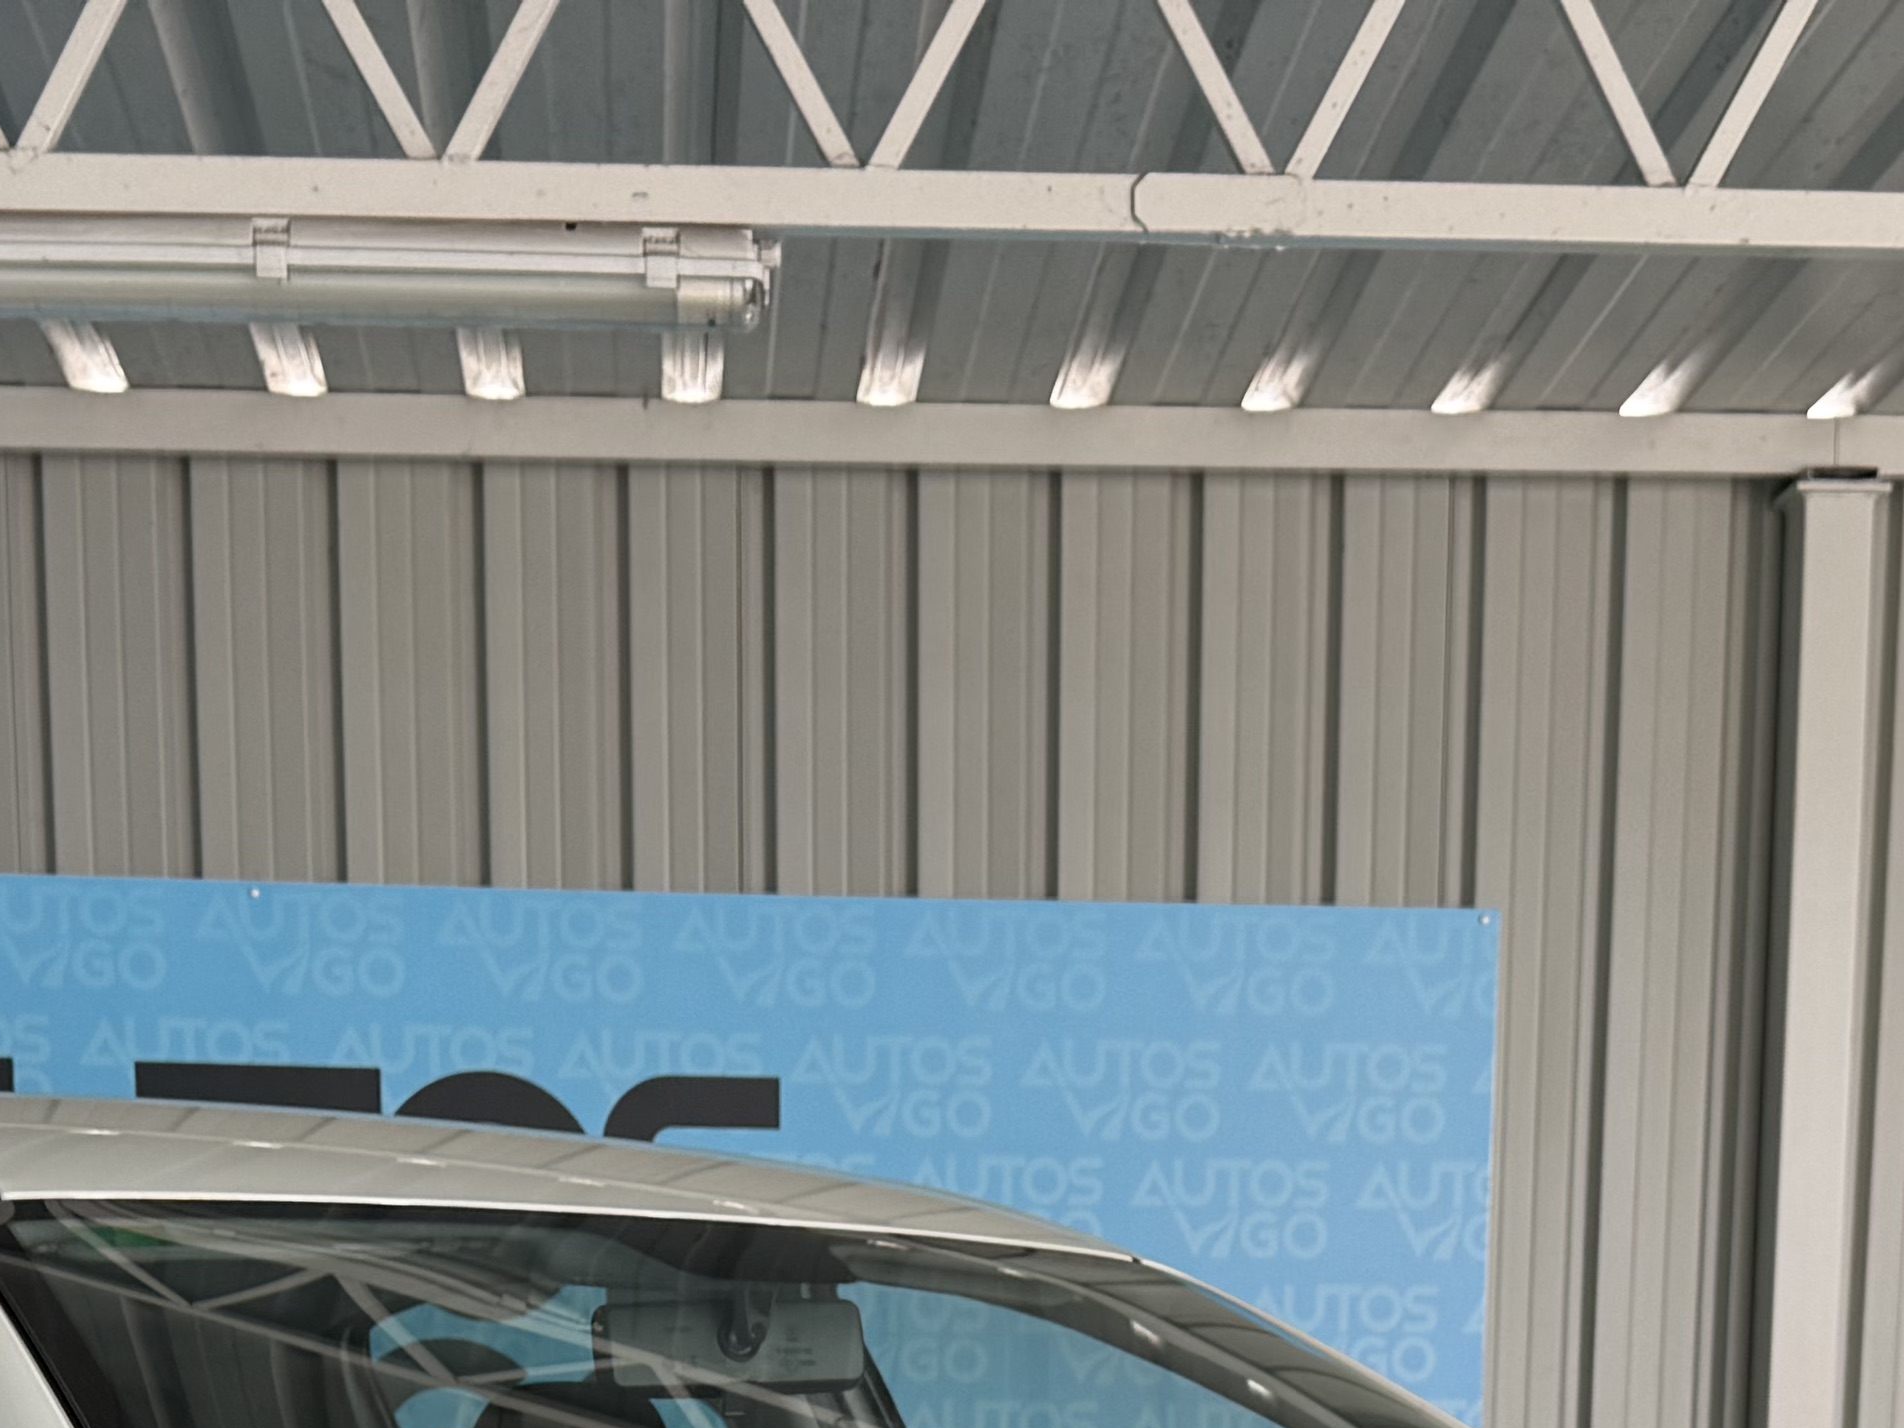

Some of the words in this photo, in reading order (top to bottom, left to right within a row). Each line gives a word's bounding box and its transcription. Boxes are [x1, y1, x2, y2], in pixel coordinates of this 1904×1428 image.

[197, 890, 406, 944] AUTOS
[436, 896, 645, 951] AUTOS
[675, 902, 877, 957] AUTOS
[901, 908, 1107, 962] AUTOS
[1131, 912, 1336, 966] AUTOS
[795, 1034, 993, 1090] AUTOS
[1020, 1036, 1222, 1091] AUTOS
[1248, 1040, 1447, 1095] AUTOS
[1131, 1158, 1329, 1211] AUTOS
